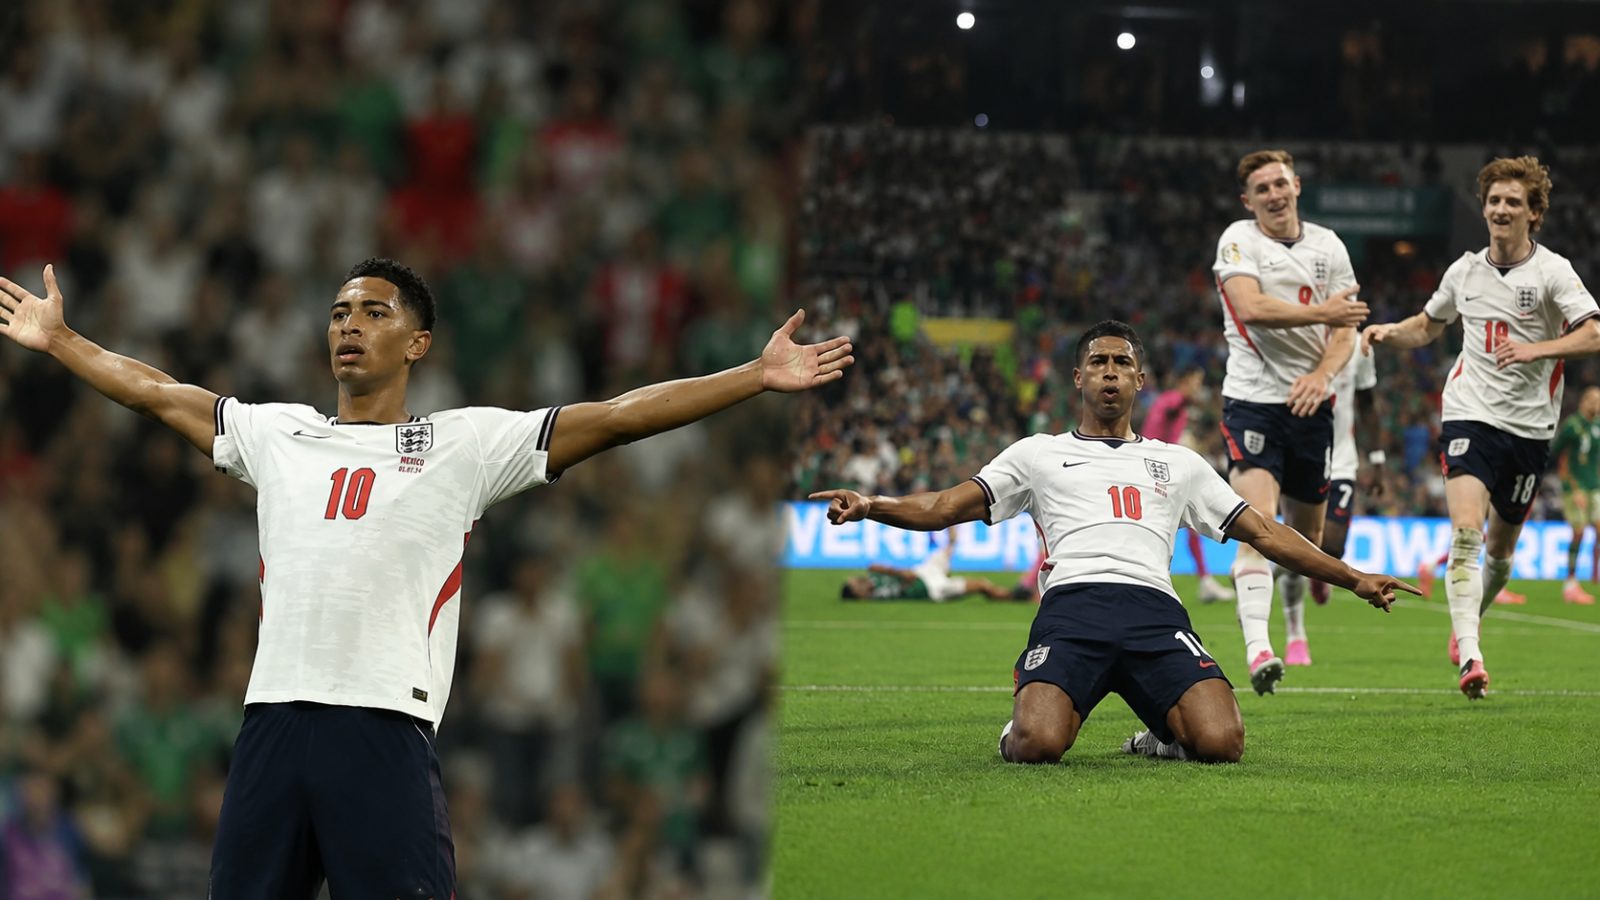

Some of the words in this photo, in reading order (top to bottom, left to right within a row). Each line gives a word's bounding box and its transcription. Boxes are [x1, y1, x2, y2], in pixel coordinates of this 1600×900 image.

[400, 456, 425, 467] MEXICO
[324, 467, 376, 520] 10
[1107, 485, 1143, 521] 10
[1339, 483, 1353, 509] 7
[1510, 473, 1536, 504] 18
